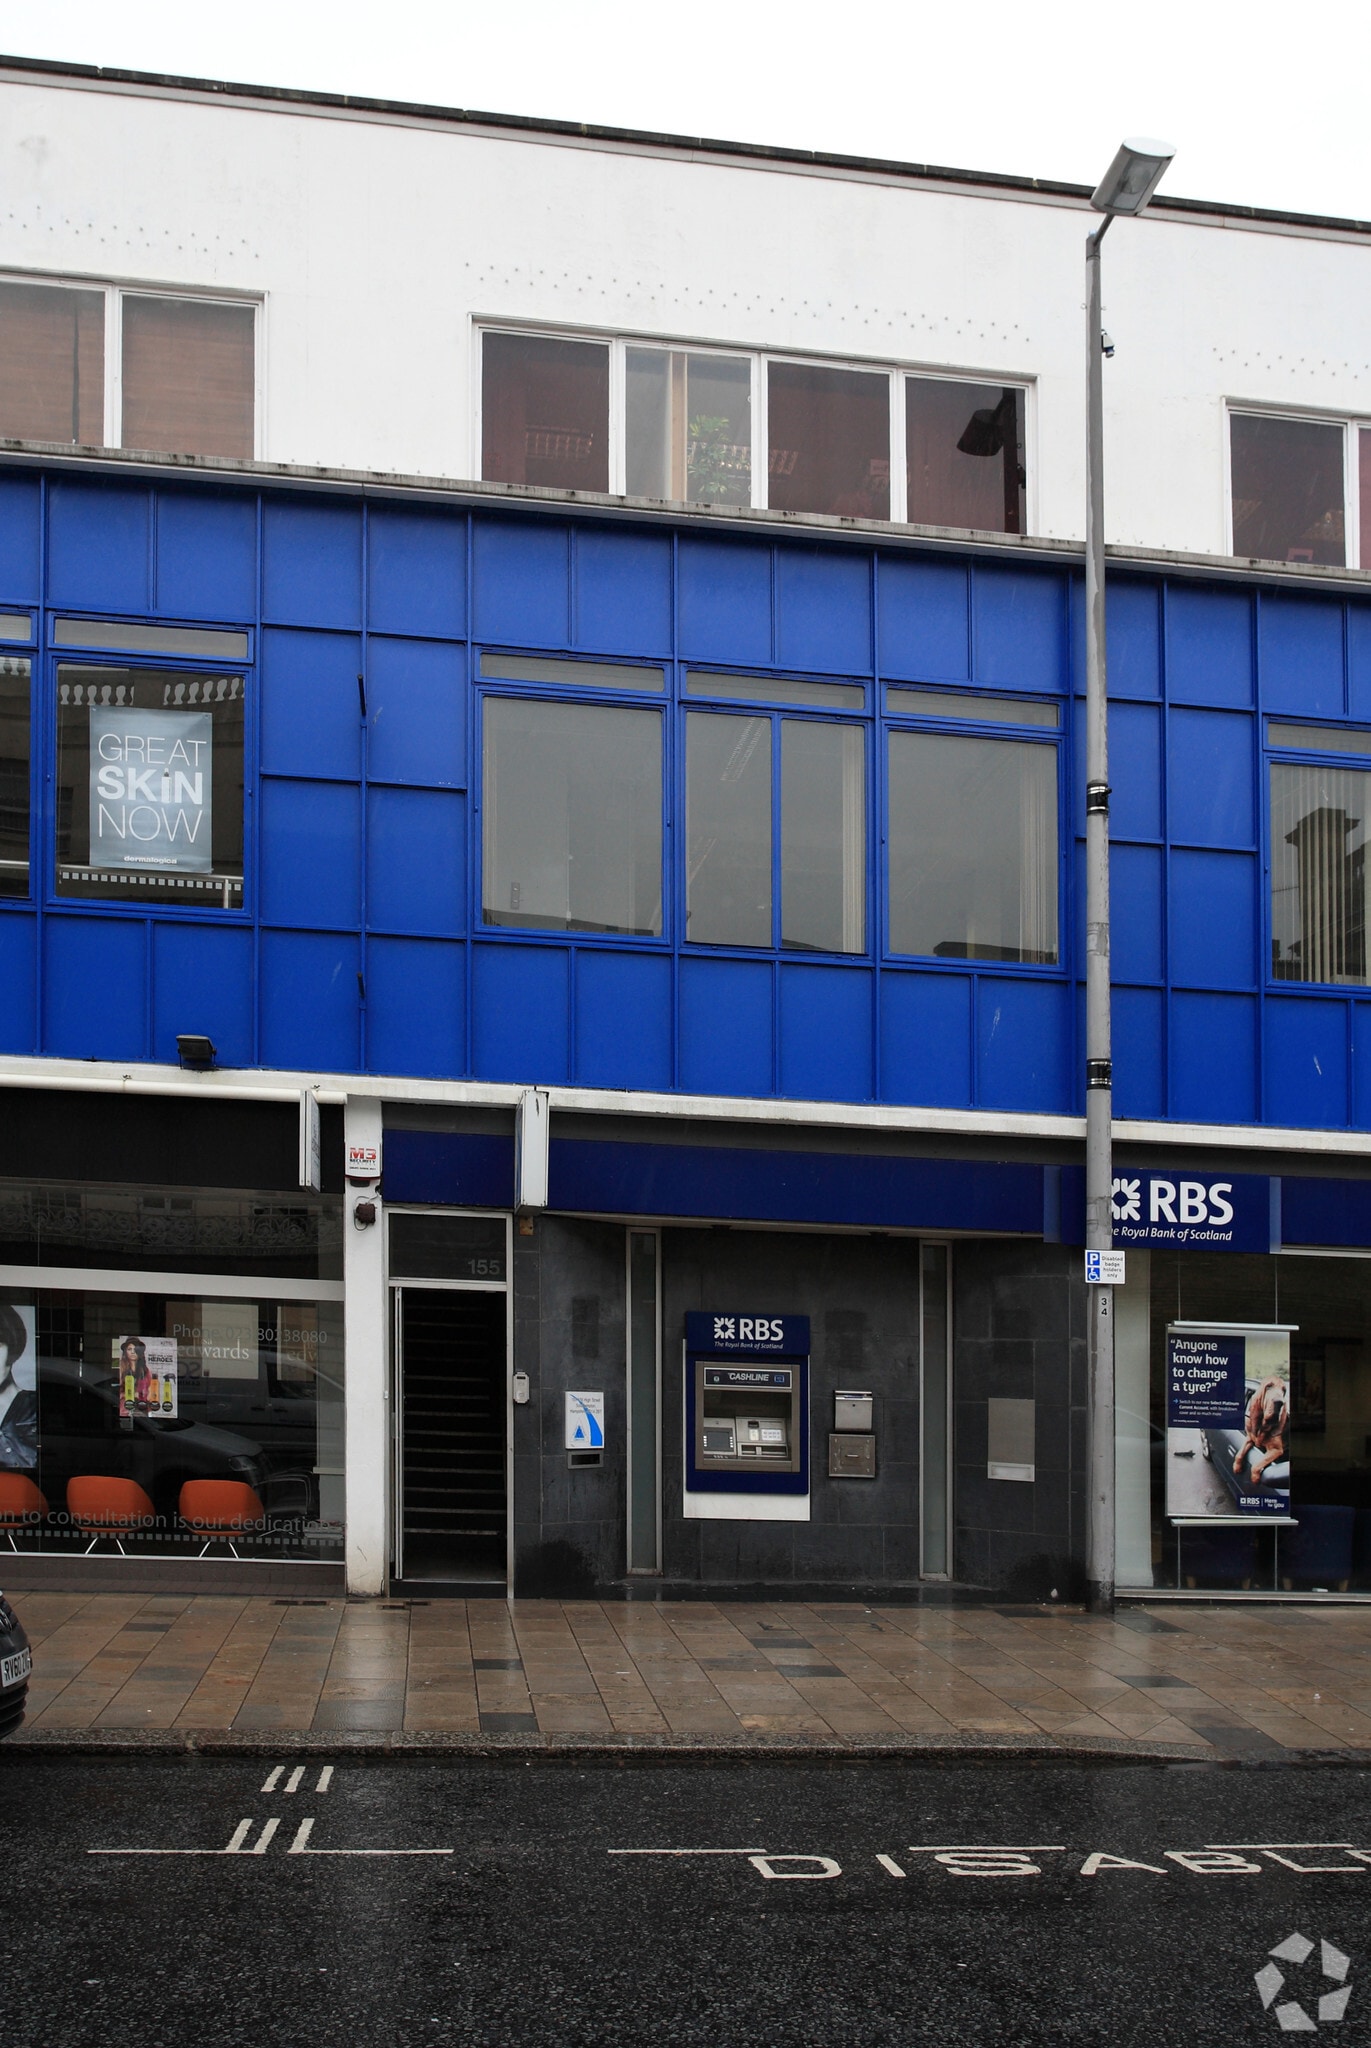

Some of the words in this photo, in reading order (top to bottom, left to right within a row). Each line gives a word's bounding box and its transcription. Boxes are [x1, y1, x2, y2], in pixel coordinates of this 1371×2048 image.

[98, 733, 207, 767] GREAT
[98, 803, 203, 843] NOW
[349, 1147, 377, 1160] M3
[1149, 1180, 1234, 1225] RBS
[1121, 1227, 1149, 1240] Royal
[1150, 1228, 1175, 1238] Bank
[1177, 1228, 1190, 1242] of
[1189, 1230, 1233, 1241] Scotland
[467, 1259, 500, 1275] 155
[173, 1324, 219, 1338] Phone
[739, 1318, 784, 1341] RBS
[177, 1337, 249, 1360] edwards
[1172, 1352, 1203, 1364] know
[1205, 1353, 1229, 1365] how
[730, 1372, 770, 1382] CASHLINE
[1172, 1367, 1185, 1377] to
[1187, 1366, 1228, 1382] change
[1172, 1382, 1180, 1391] a
[22, 1508, 41, 1523] to
[46, 1508, 167, 1527] consultation
[173, 1511, 186, 1528] is
[192, 1515, 225, 1530] our
[230, 1513, 331, 1533] dedication
[748, 1850, 1371, 1879] DISABL
